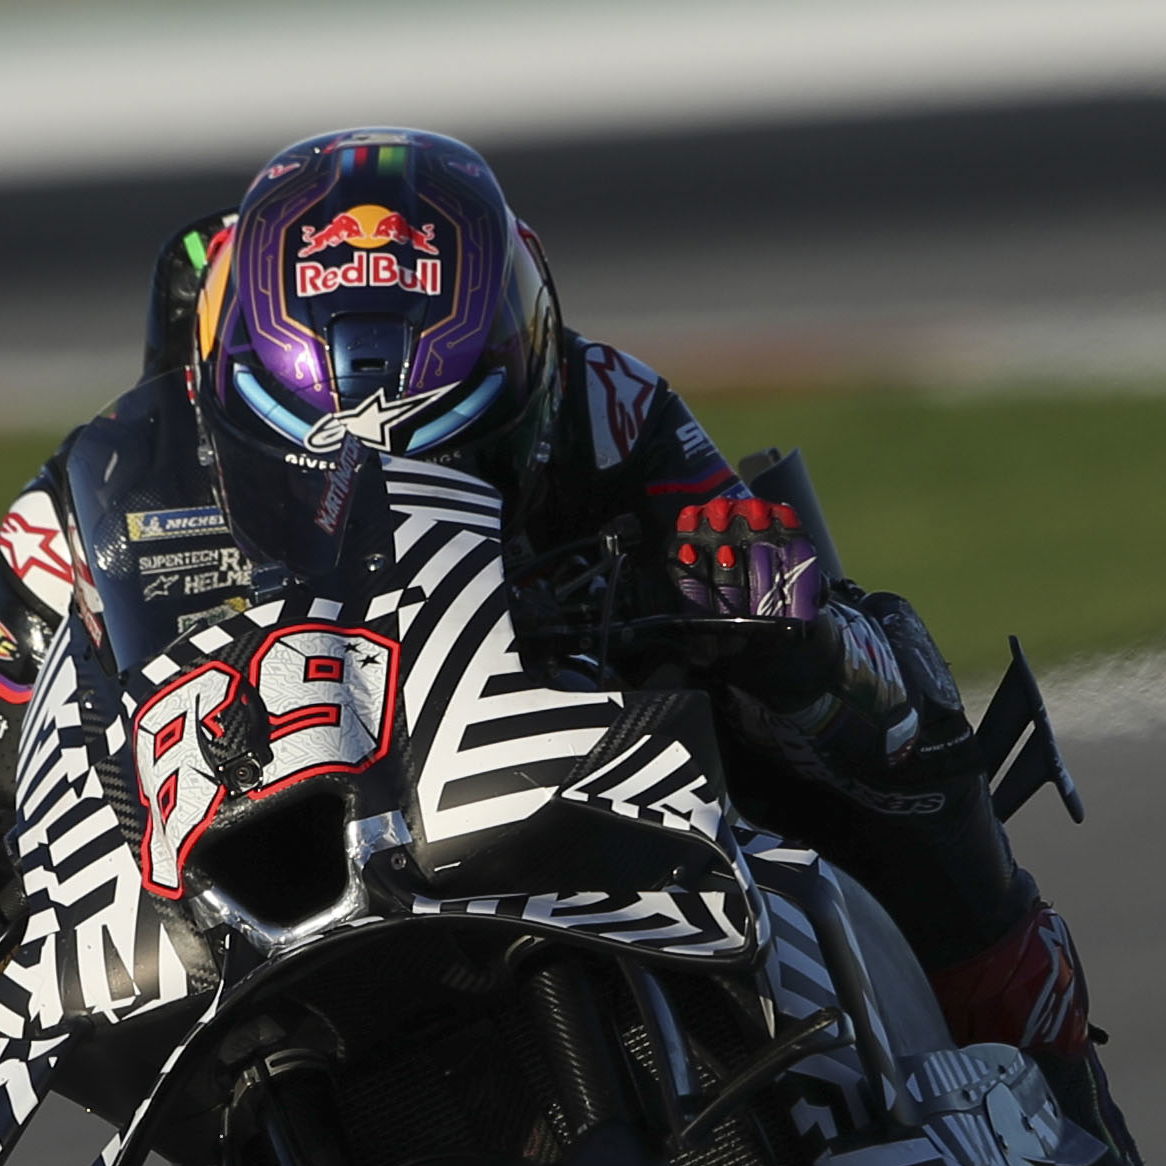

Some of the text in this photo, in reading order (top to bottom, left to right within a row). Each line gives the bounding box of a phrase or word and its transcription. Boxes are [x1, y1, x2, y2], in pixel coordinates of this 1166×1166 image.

[296, 251, 441, 297] Red Bull
[140, 550, 219, 571] SUPERTECH
